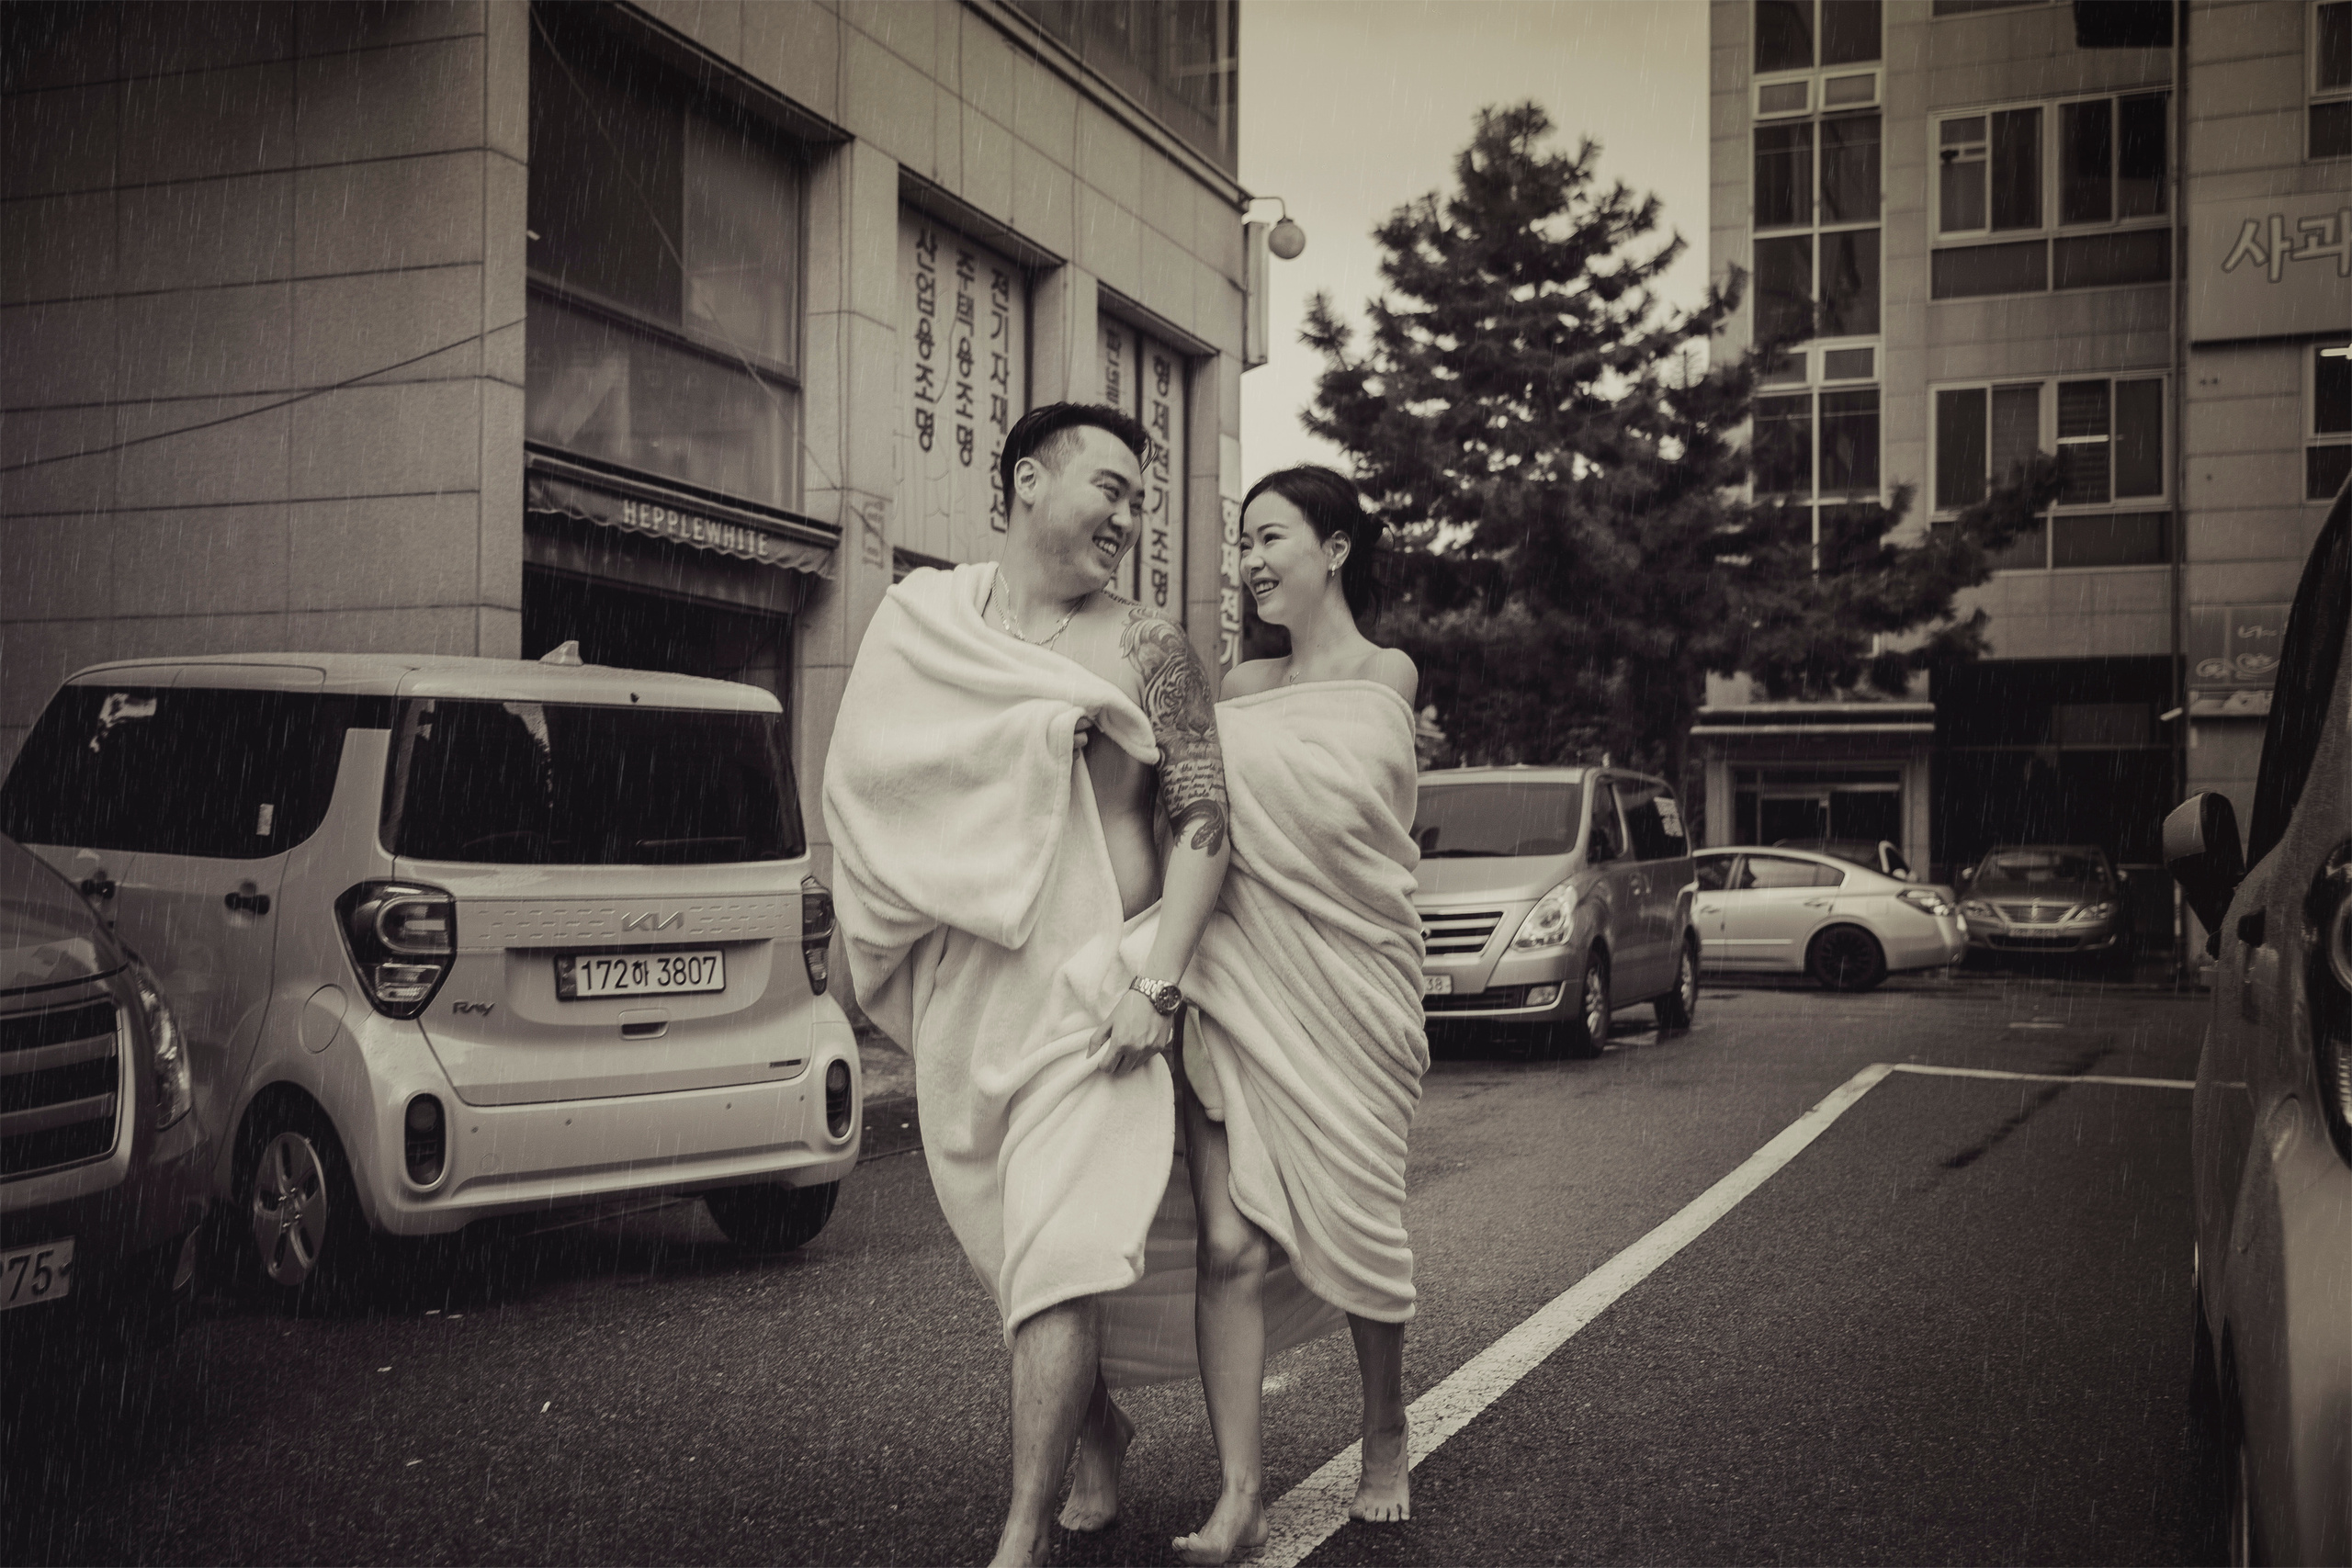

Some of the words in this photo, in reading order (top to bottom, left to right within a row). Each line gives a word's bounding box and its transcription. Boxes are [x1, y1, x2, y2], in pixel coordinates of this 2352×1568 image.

[956, 248, 975, 468] 주택용조명
[623, 499, 769, 557] HEPPLEWHITE
[621, 910, 684, 931] KIA
[581, 958, 650, 991] 172하
[657, 955, 718, 987] 3807
[0, 1249, 54, 1303] 75
